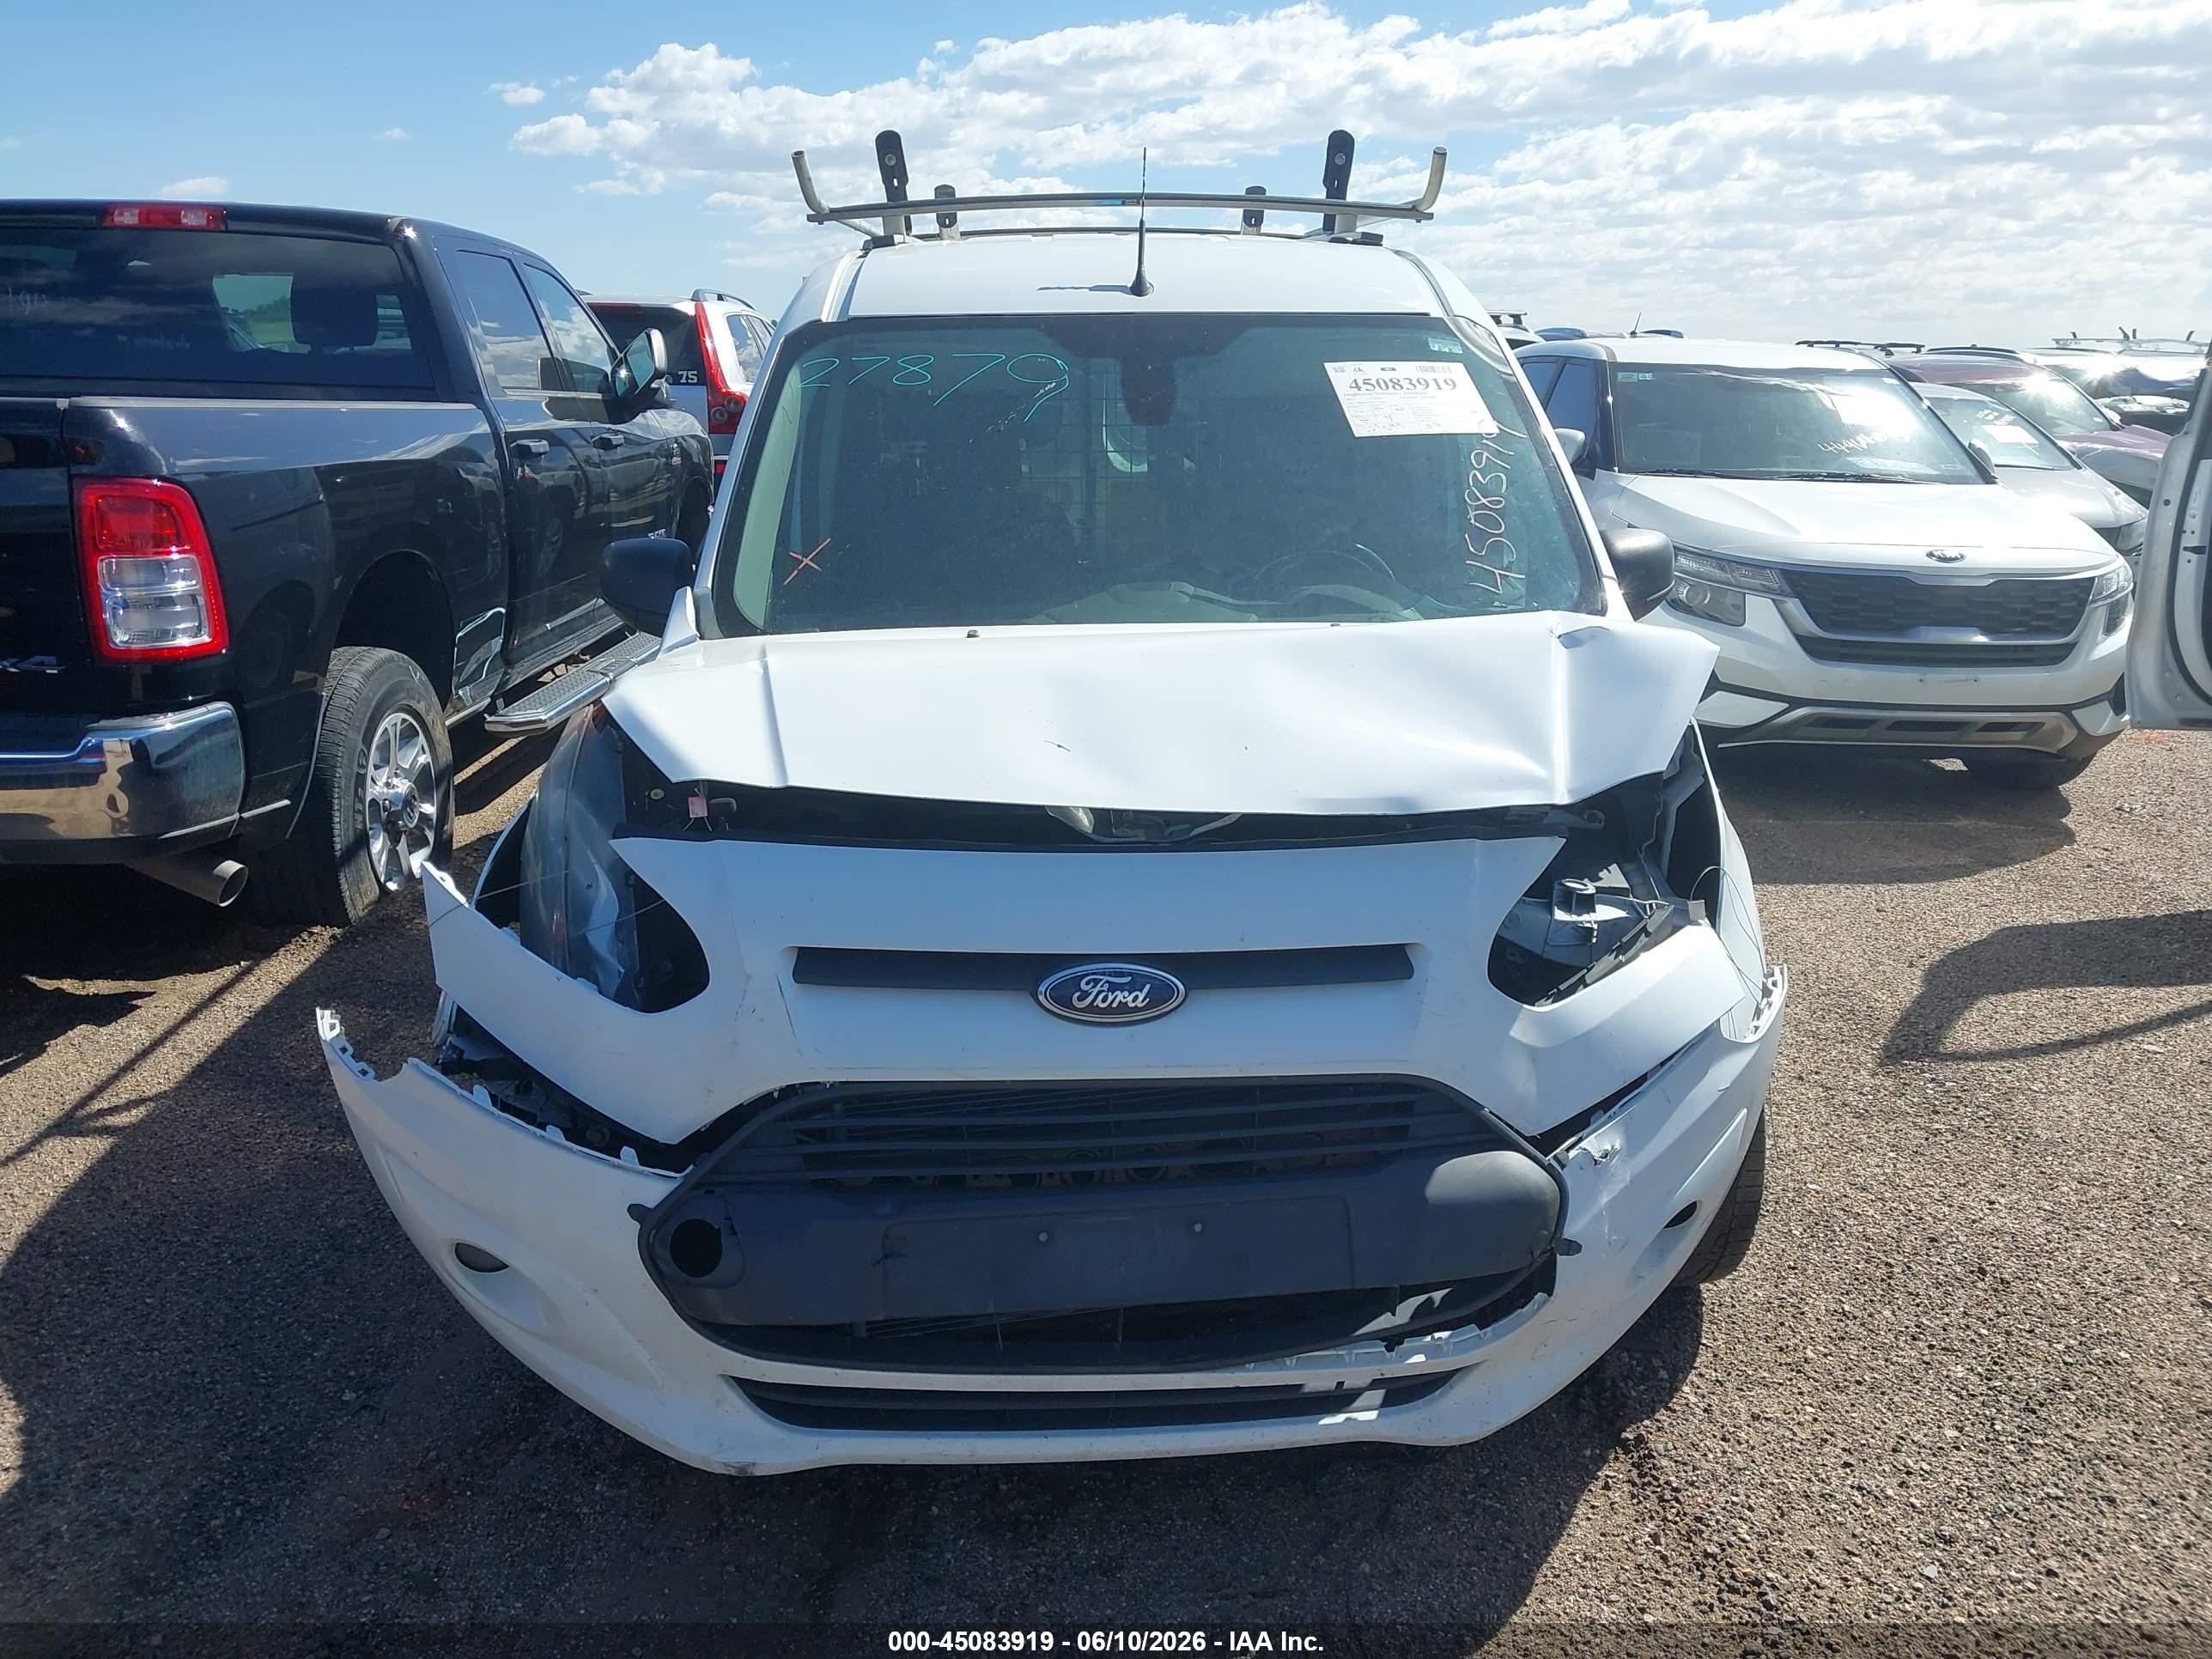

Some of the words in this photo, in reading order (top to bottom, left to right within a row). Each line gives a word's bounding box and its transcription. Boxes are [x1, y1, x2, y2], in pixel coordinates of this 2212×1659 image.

[678, 370, 698, 384] 75
[798, 353, 1070, 423] 27879
[1348, 376, 1458, 392] 45083919
[1072, 975, 1152, 1008] Ford
